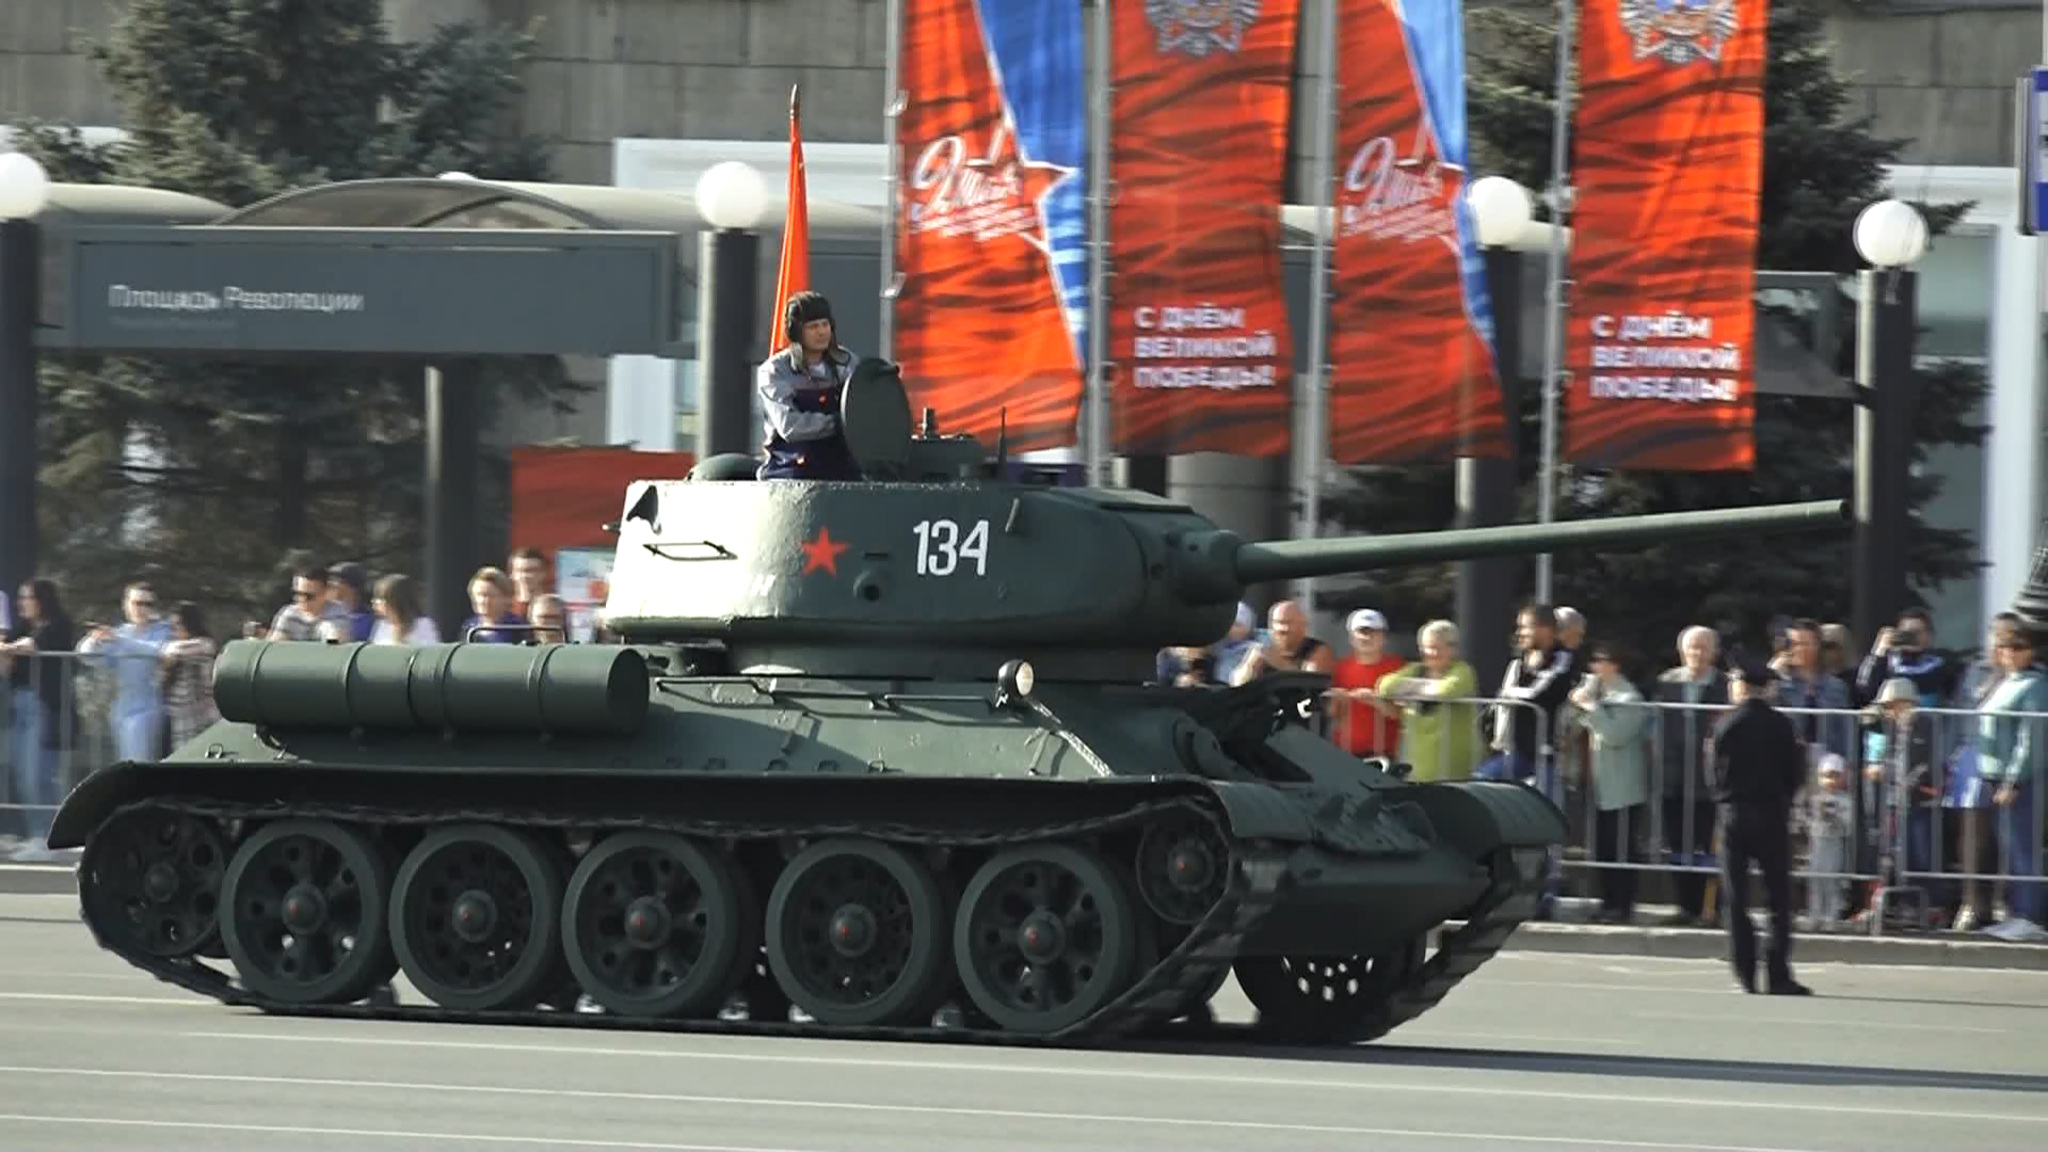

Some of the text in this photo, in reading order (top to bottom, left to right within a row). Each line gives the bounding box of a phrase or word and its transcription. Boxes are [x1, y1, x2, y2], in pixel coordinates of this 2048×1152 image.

[109, 284, 365, 314] Площадь Революции
[1134, 302, 1246, 331] С ДНЁМ
[1590, 309, 1713, 340] С ДНЁМ
[1134, 330, 1277, 357] ВЕЛИКОЙ
[1590, 342, 1741, 370] ВЕЛИКОЙ
[913, 519, 990, 576] 134
